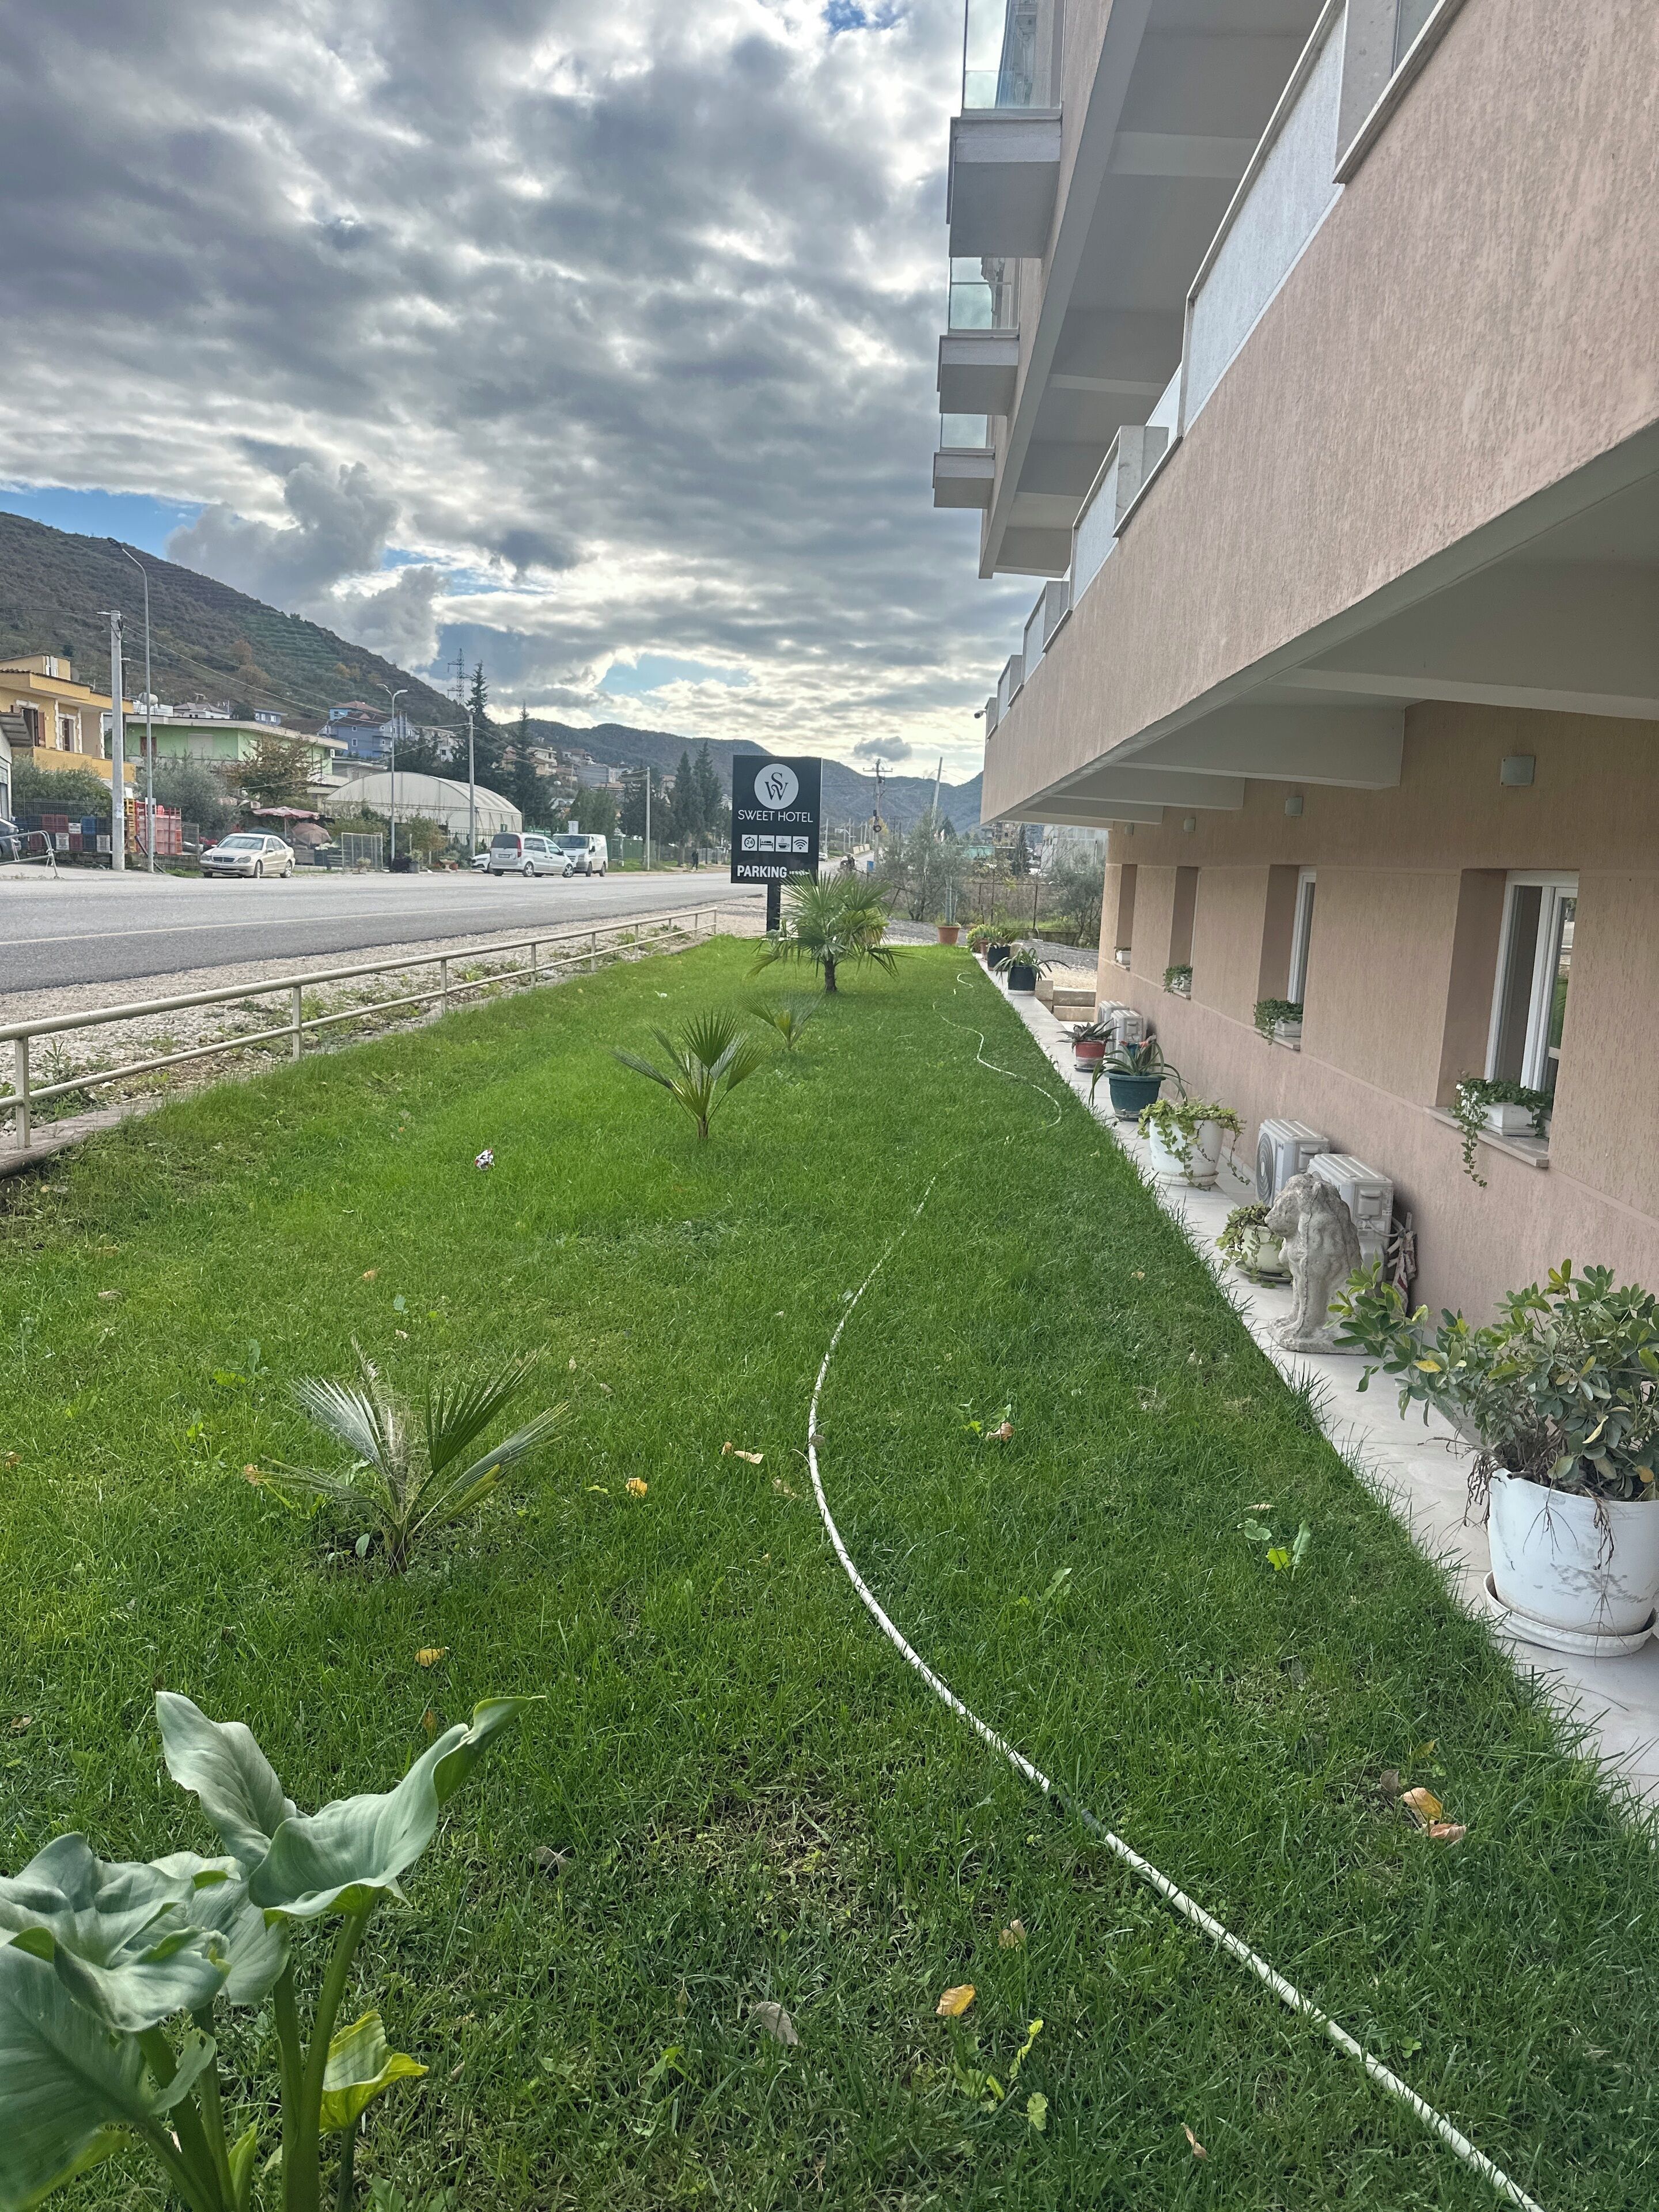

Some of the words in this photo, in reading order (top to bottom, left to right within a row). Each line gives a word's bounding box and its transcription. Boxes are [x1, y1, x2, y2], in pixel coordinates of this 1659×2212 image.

[737, 809, 775, 821] SWEET
[778, 811, 813, 823] HOTEL
[737, 865, 787, 878] PARKING
